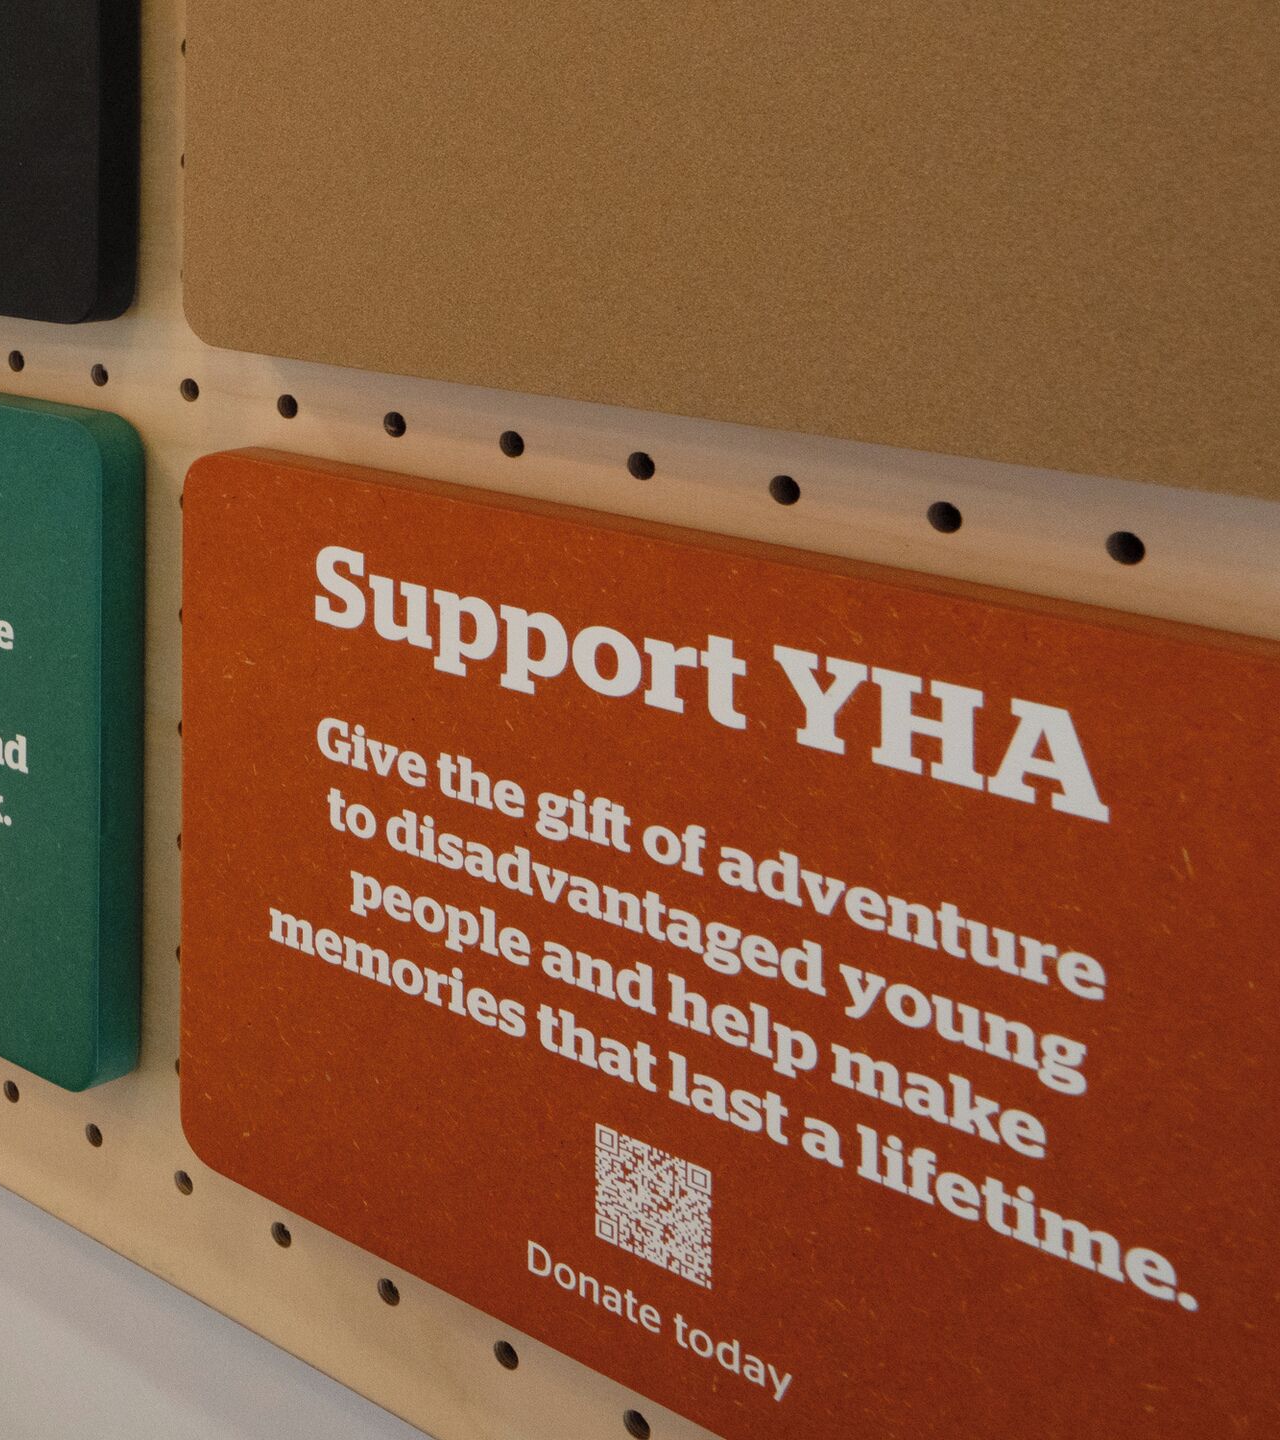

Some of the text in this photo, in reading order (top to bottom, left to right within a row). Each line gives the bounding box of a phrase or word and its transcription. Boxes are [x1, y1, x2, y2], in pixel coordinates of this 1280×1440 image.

[314, 545, 1110, 824] Support YHA
[316, 717, 1107, 1001] Give the gift of adventure
[326, 787, 1088, 1096] to disadvantaged young
[269, 907, 1199, 1312] memories that last a lifetime.
[350, 870, 1047, 1159] people and help make
[527, 1240, 792, 1402] Donate today
